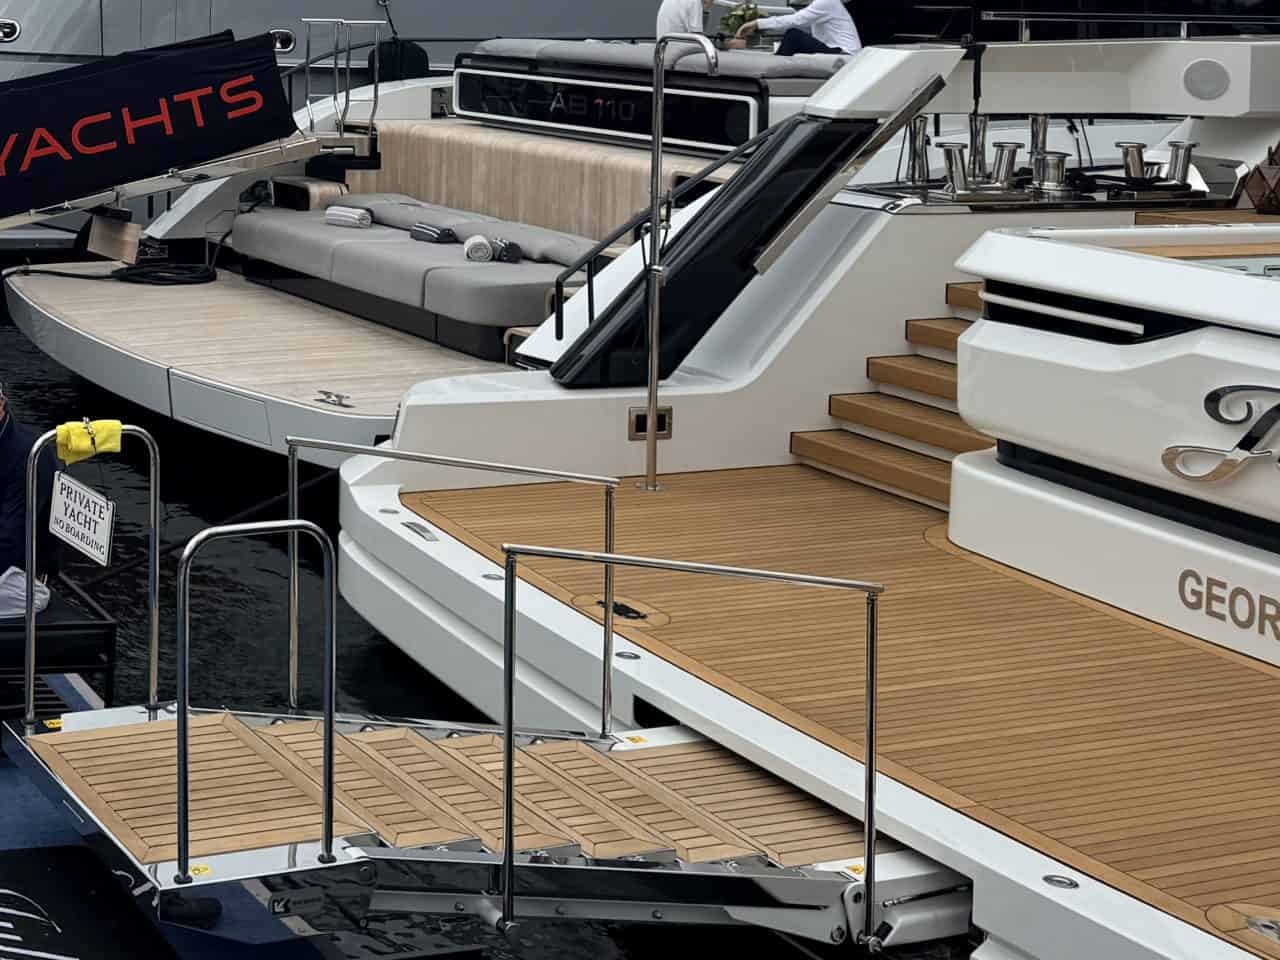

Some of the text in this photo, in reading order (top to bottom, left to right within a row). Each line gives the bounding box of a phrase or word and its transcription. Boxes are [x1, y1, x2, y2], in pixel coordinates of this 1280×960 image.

[549, 91, 587, 116] AB
[60, 482, 105, 520] PRIVATE
[63, 501, 99, 535] YACHT
[54, 515, 105, 556] NO BOARDING
[1177, 568, 1280, 642] GEOR
